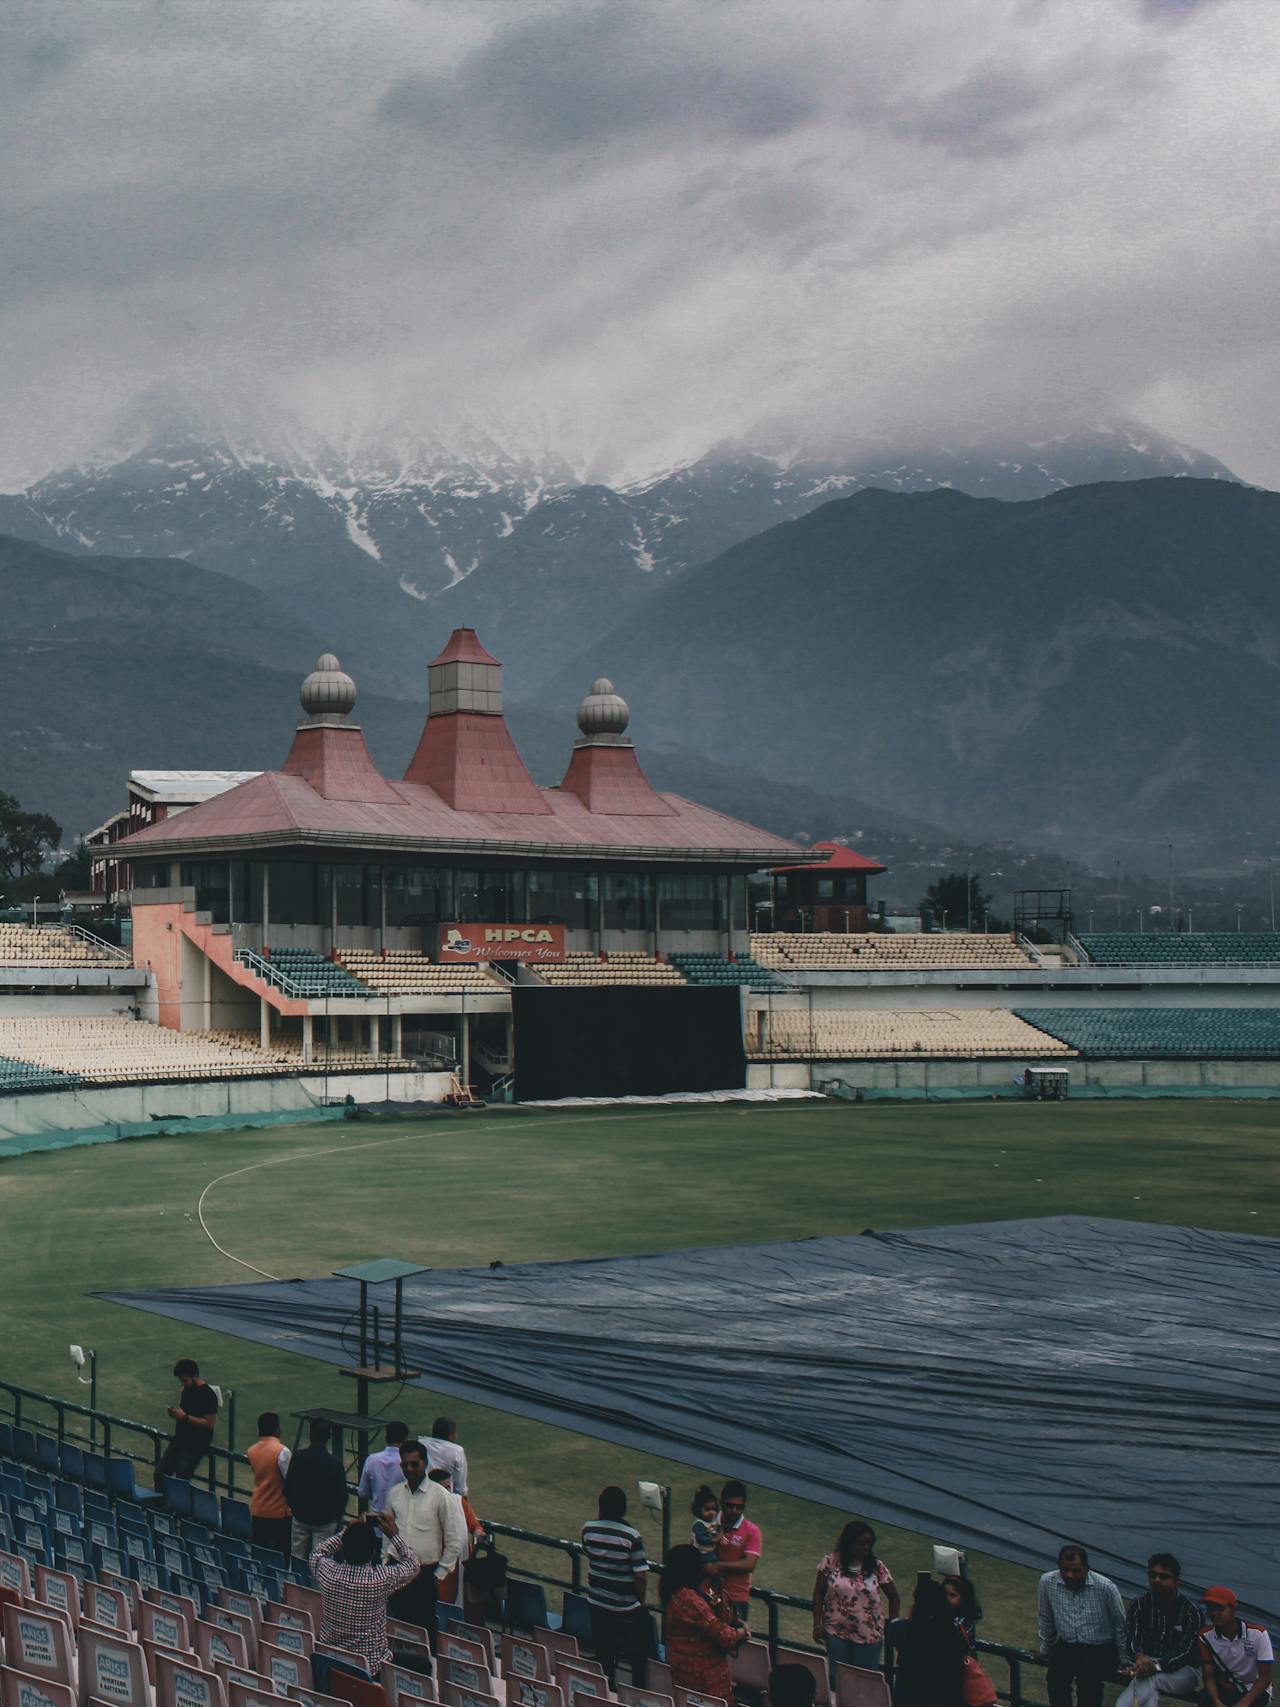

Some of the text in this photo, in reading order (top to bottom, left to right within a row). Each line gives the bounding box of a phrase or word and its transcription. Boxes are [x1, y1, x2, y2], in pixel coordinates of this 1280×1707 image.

[484, 928, 554, 943] HPCA
[472, 945, 560, 959] Welcomes You
[22, 1625, 49, 1642] ARISE
[25, 1643, 49, 1653] INVERTERS
[29, 1651, 52, 1661] BATTERIES
[99, 1656, 128, 1677] ARISE
[101, 1676, 127, 1688] INVERTERS
[176, 1677, 206, 1700] ARISE
[105, 1684, 130, 1697] BATTERIES
